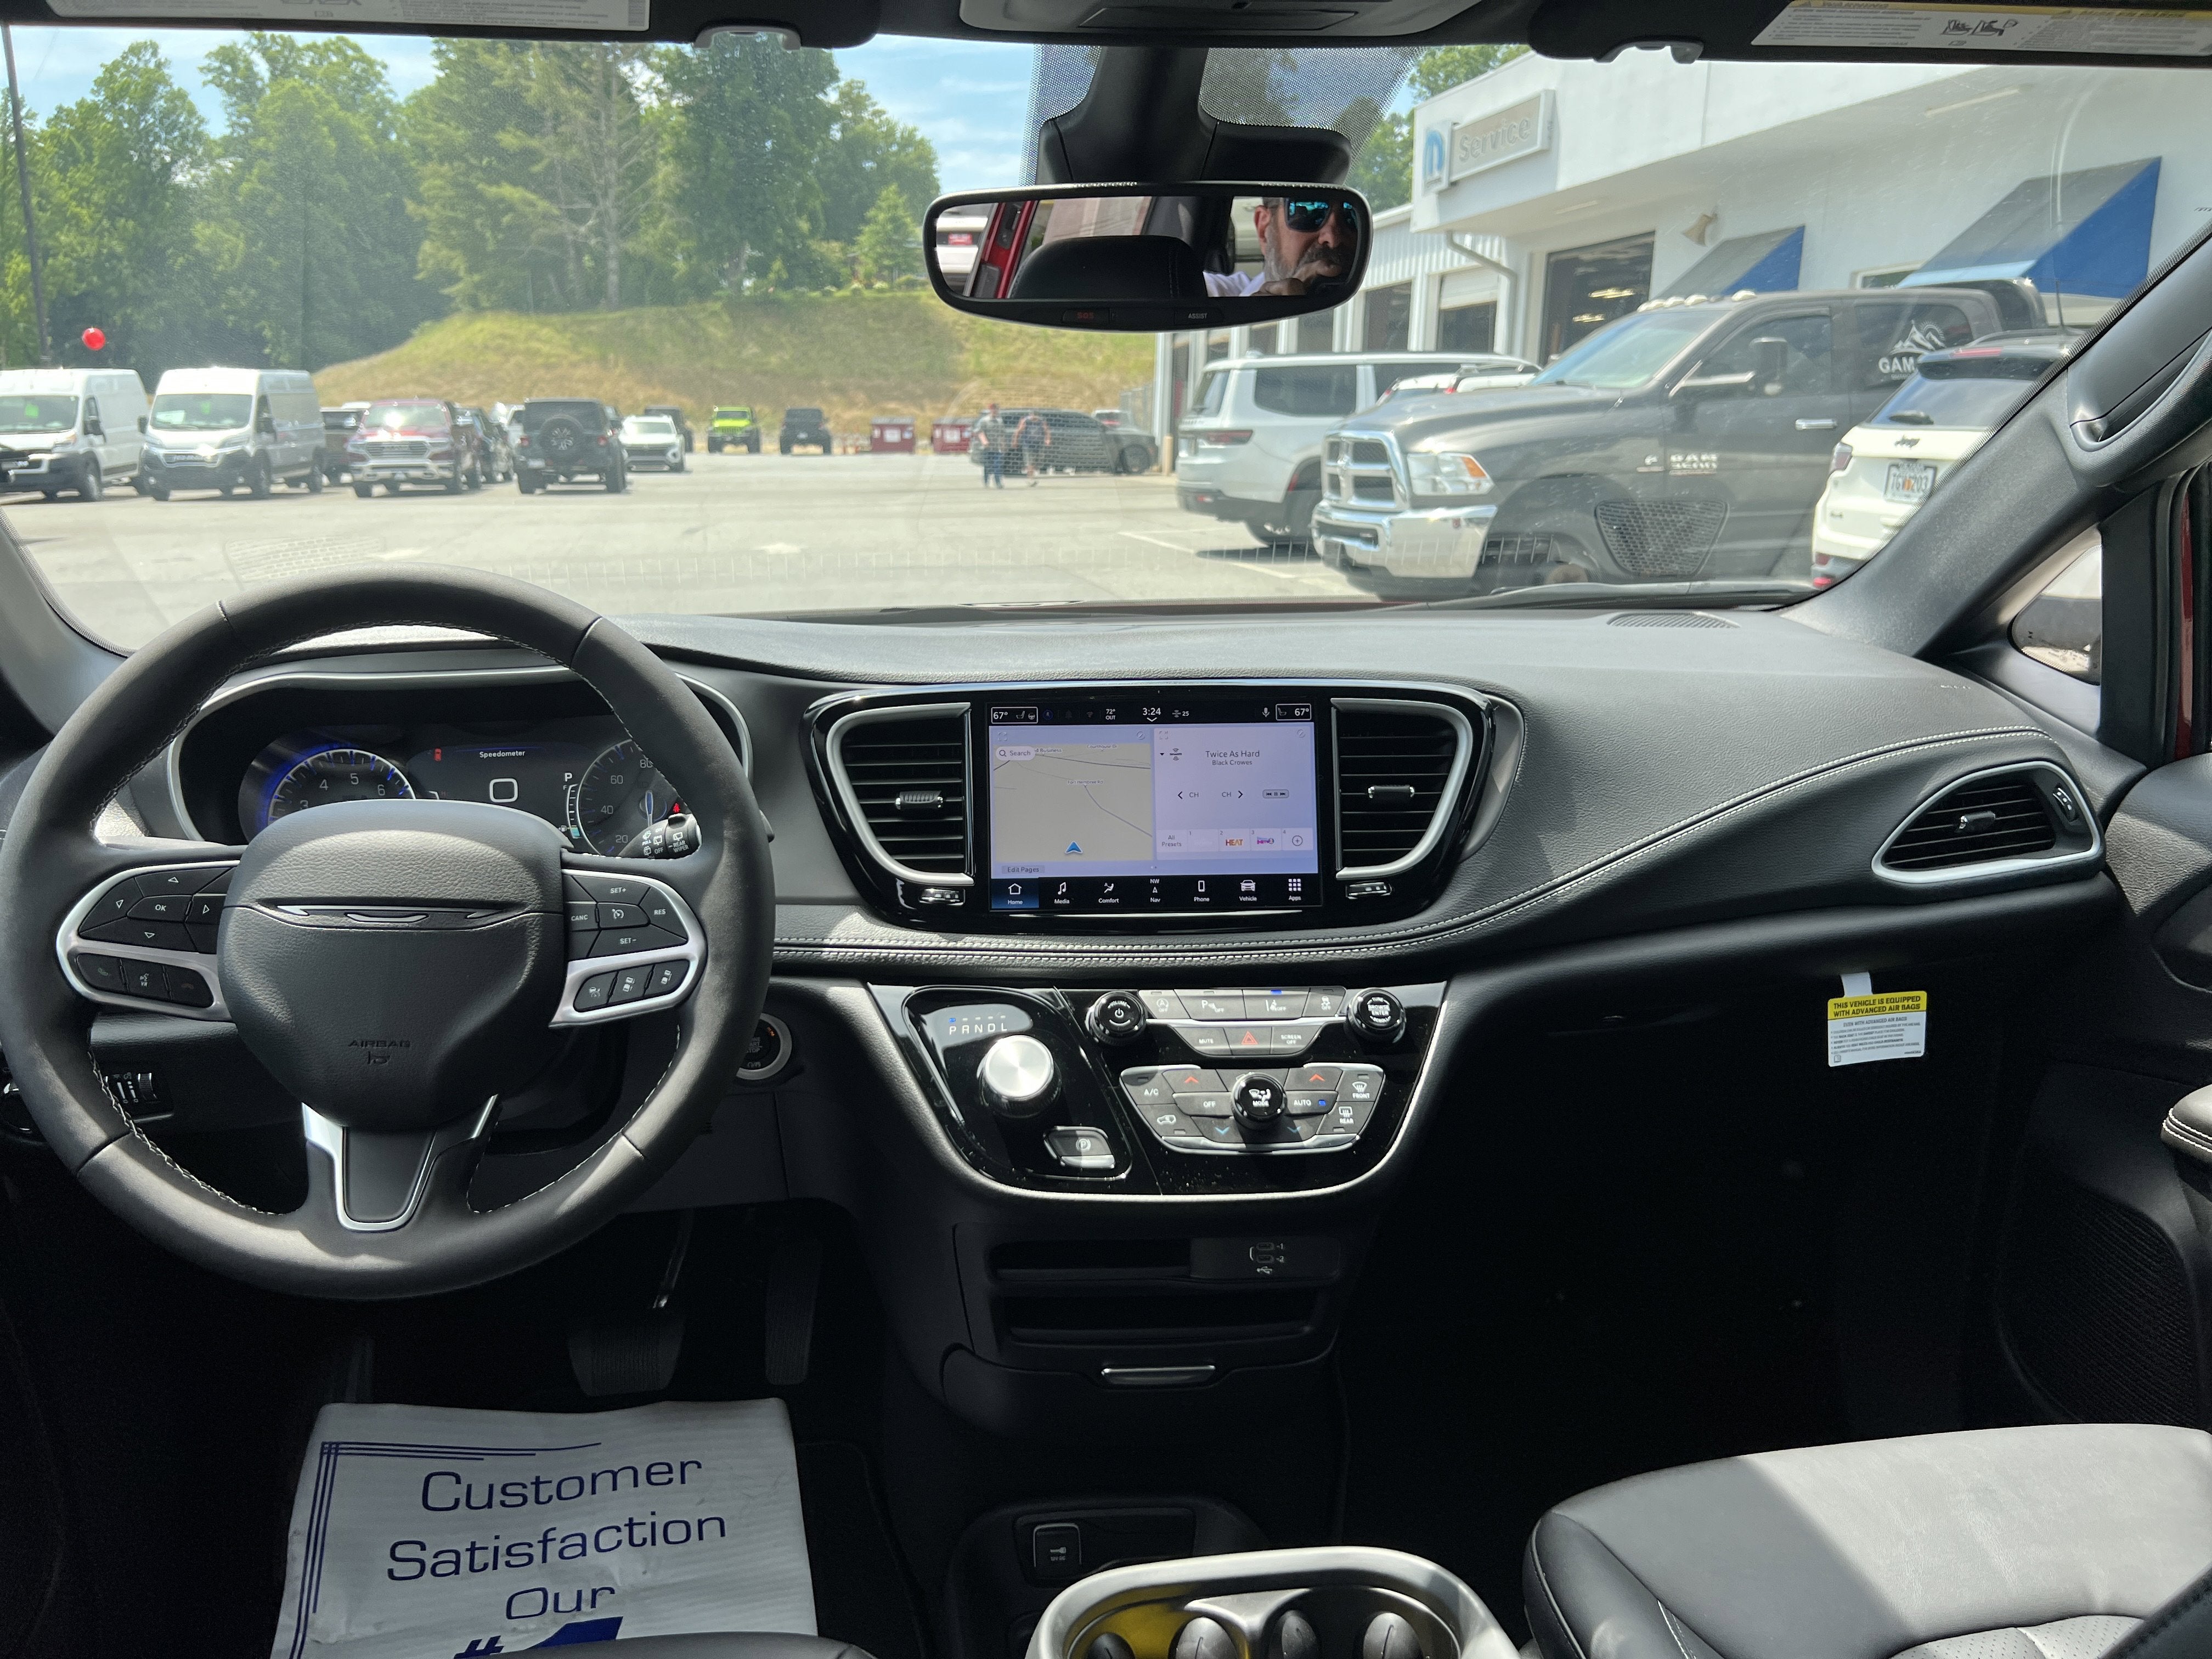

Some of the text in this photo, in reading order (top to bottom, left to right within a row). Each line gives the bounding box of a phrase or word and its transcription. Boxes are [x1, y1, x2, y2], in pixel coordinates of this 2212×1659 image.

[1458, 118, 1531, 162] Service
[479, 751, 525, 759] Speedometer
[350, 773, 359, 785] 5
[565, 772, 572, 782] P
[611, 775, 624, 785] 60
[319, 779, 329, 791] 4
[377, 785, 386, 796] 6
[601, 806, 614, 815] 40
[616, 834, 628, 843] 20
[673, 844, 690, 853] WIPER
[1849, 999, 1876, 1008] VEHICLE
[1886, 996, 1921, 1004] EQUIPPED
[1852, 1006, 1887, 1015] ADVANCED
[949, 1026, 957, 1035] P
[974, 1024, 983, 1034] N
[988, 1023, 996, 1032] D
[1001, 1022, 1008, 1032] L
[1144, 1088, 1159, 1096] A/C
[420, 1458, 703, 1512] Customer
[386, 1510, 727, 1581] Satisfaction
[505, 1585, 616, 1620] Our
